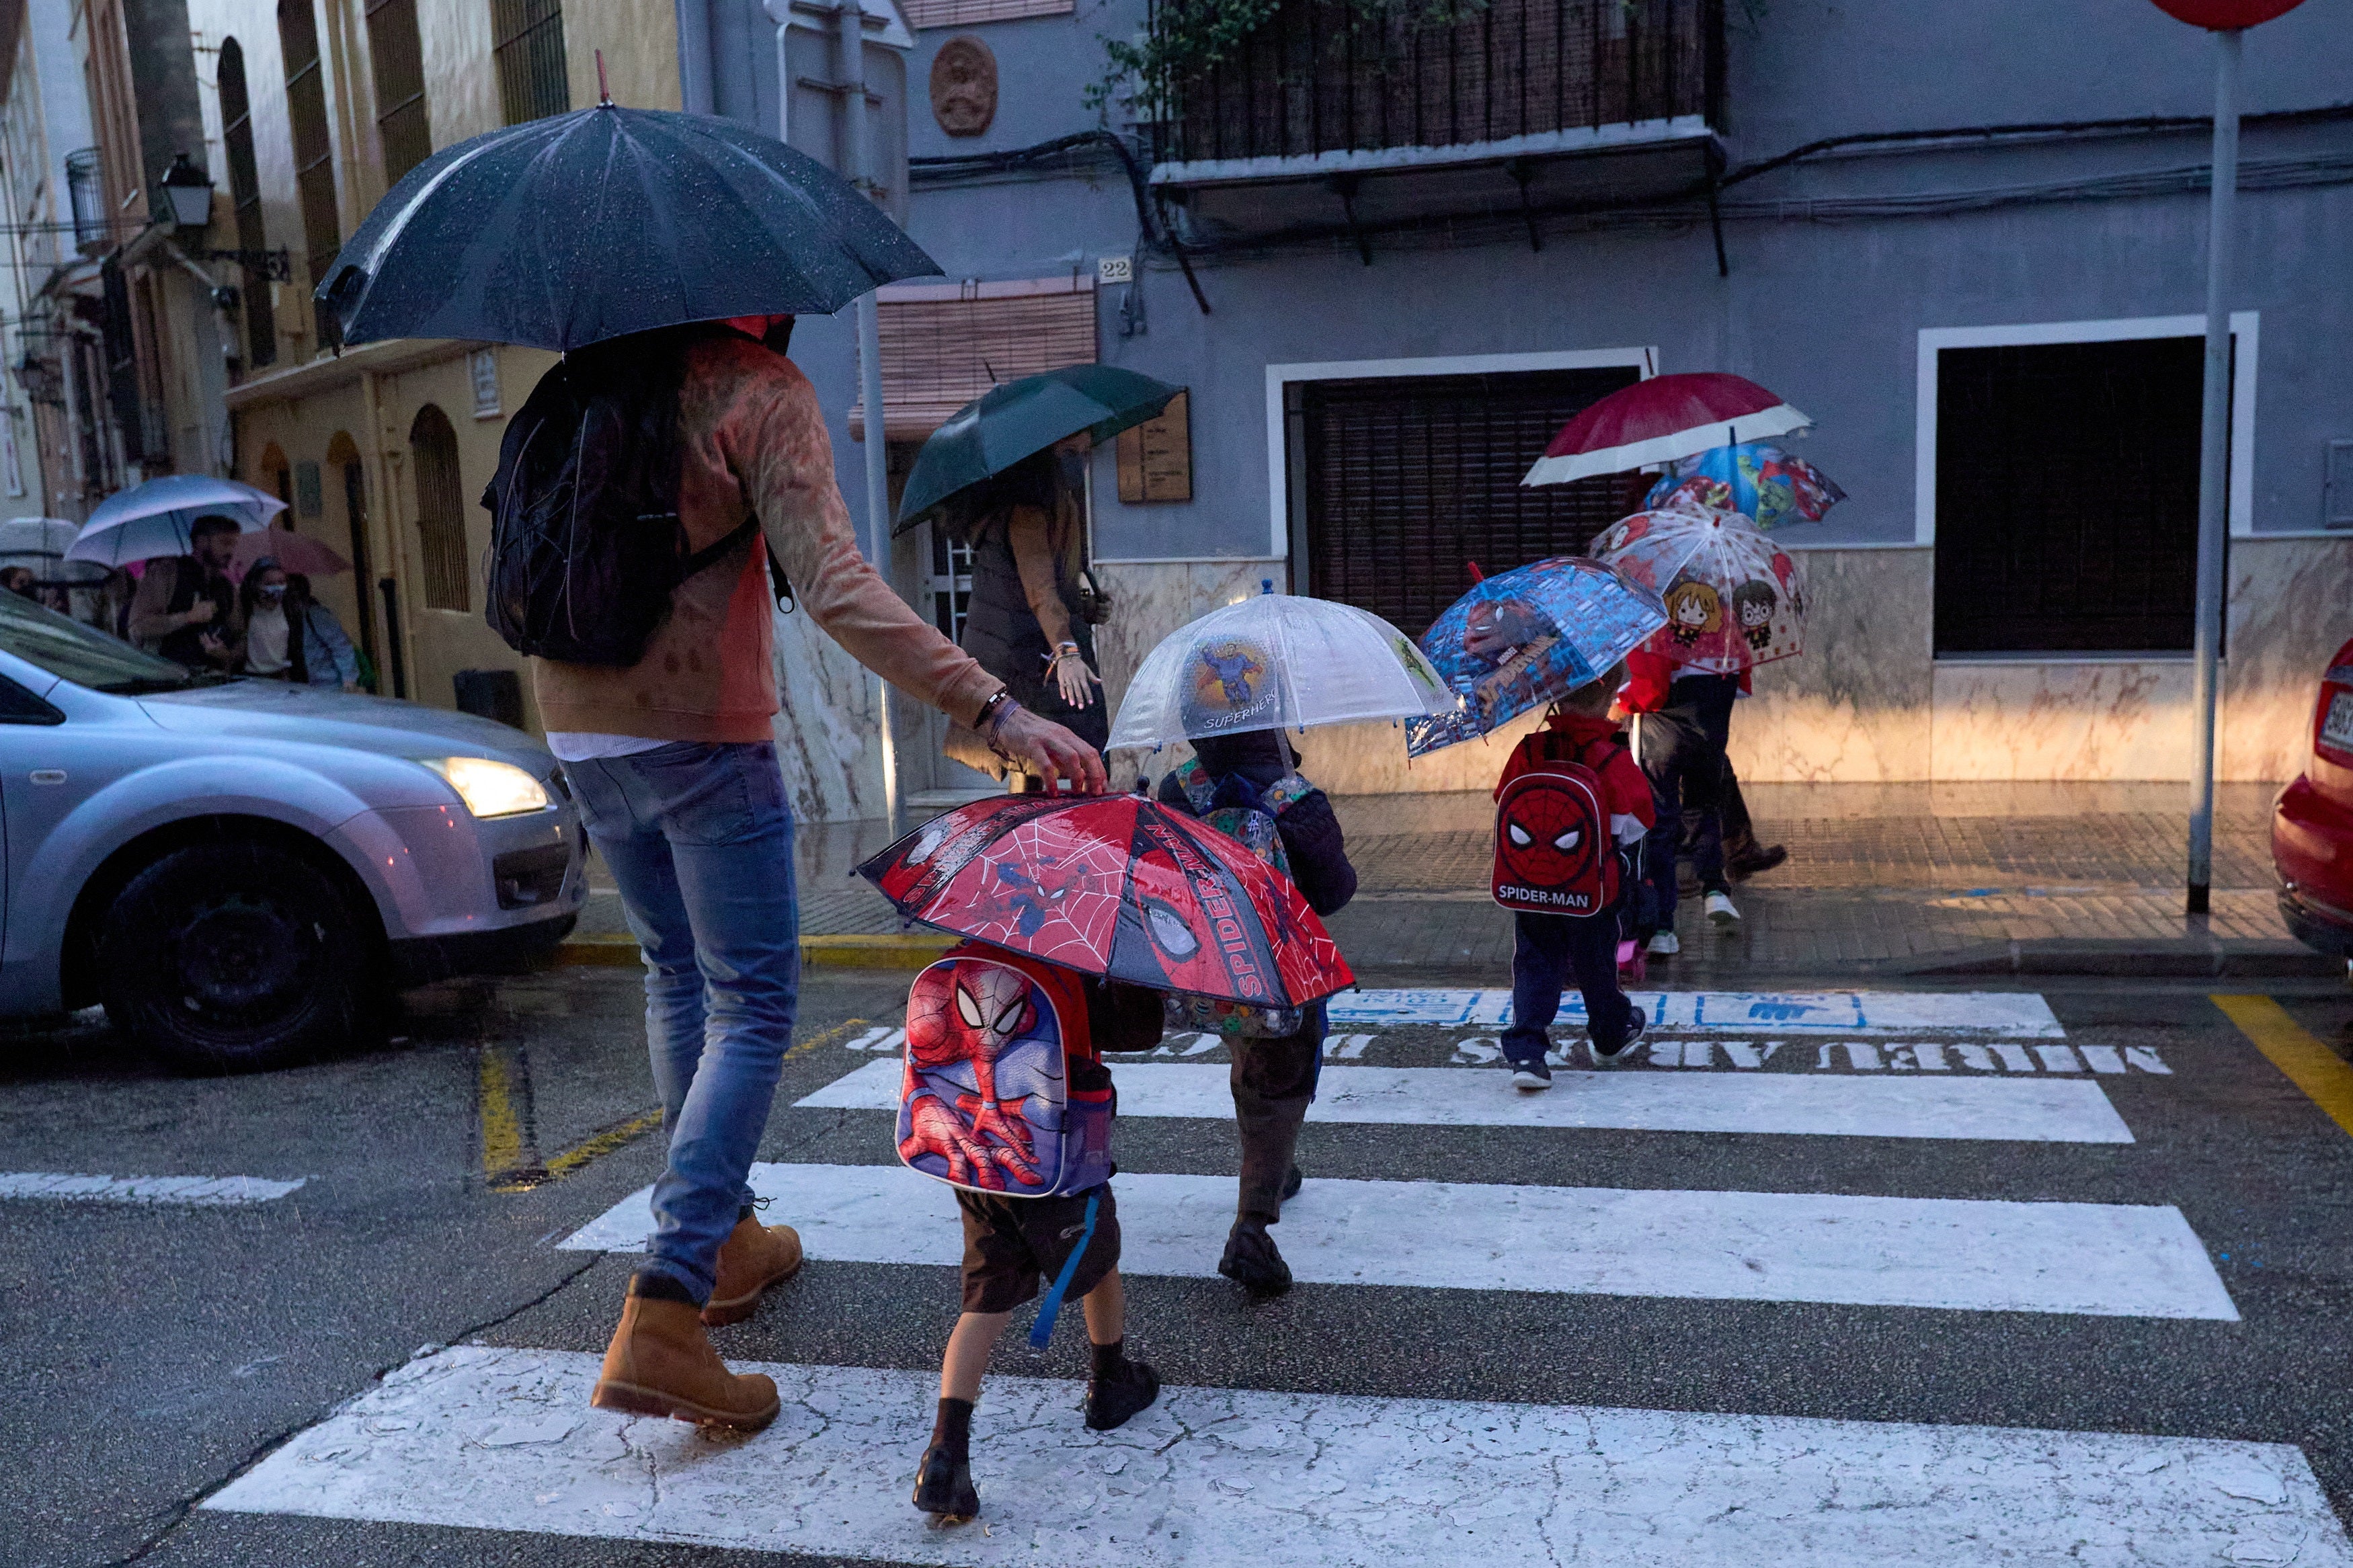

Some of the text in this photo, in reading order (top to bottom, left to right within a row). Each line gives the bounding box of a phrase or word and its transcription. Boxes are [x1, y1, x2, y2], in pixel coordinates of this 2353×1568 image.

[1103, 261, 1127, 277] 22
[1499, 885, 1589, 907] SPIDER-MAN
[1145, 824, 1262, 997] SPIDER-MAN
[1817, 1042, 2173, 1075] MIREU
